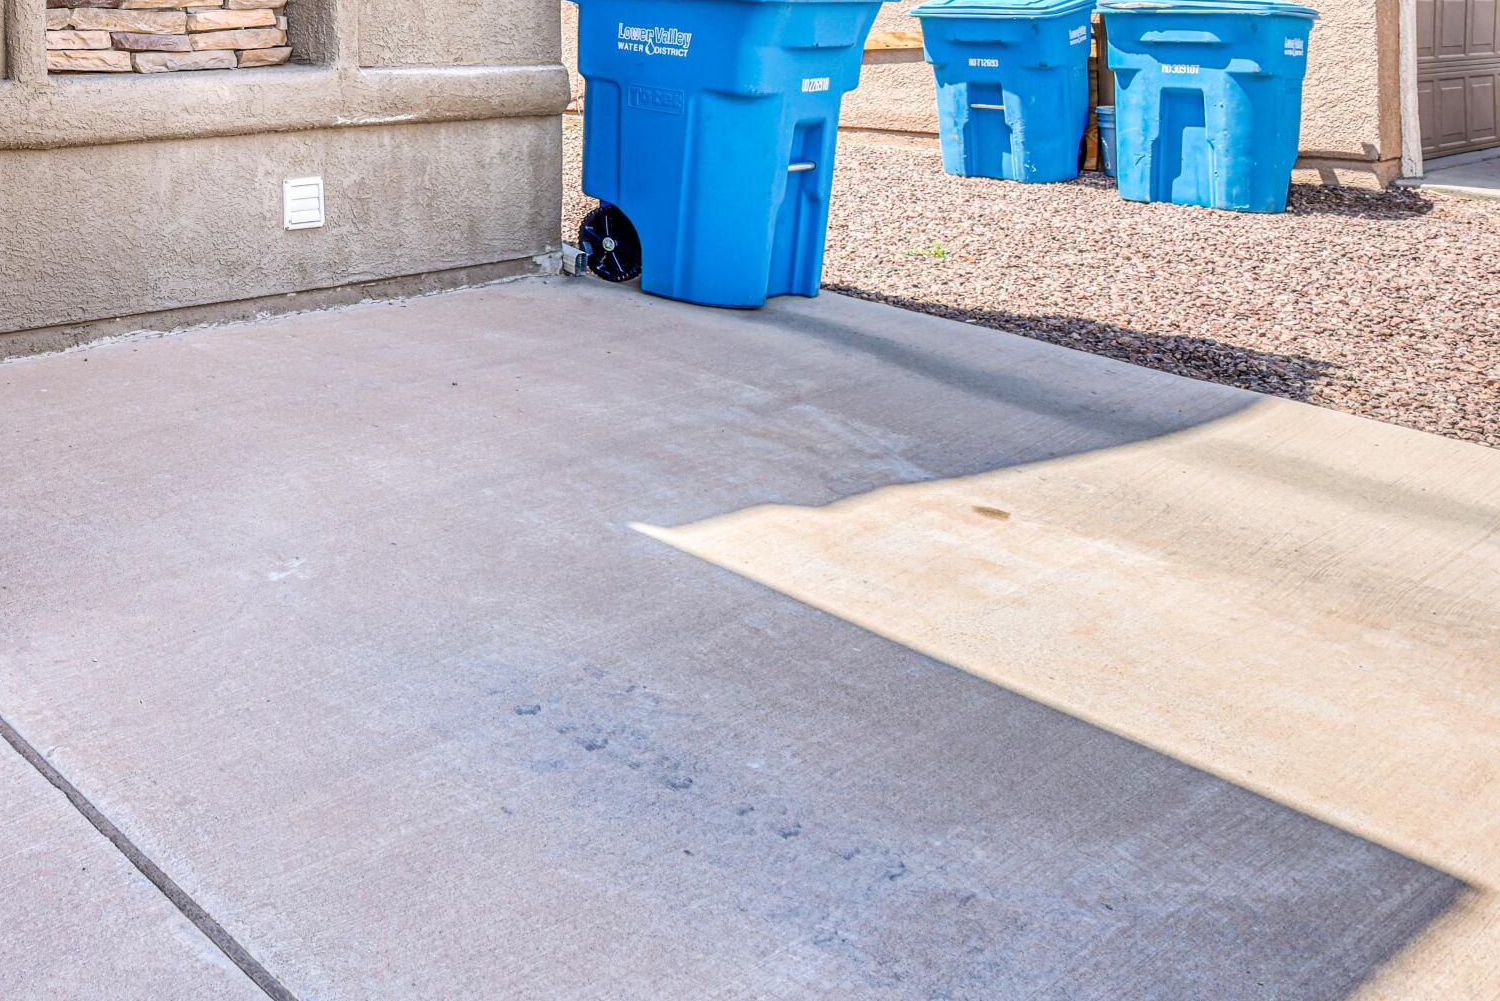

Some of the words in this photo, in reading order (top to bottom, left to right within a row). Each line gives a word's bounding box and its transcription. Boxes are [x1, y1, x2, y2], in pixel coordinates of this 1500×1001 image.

[617, 22, 654, 42] Lower
[654, 26, 692, 49] Valley
[617, 41, 644, 52] WATER
[653, 46, 689, 57] DISTRICT
